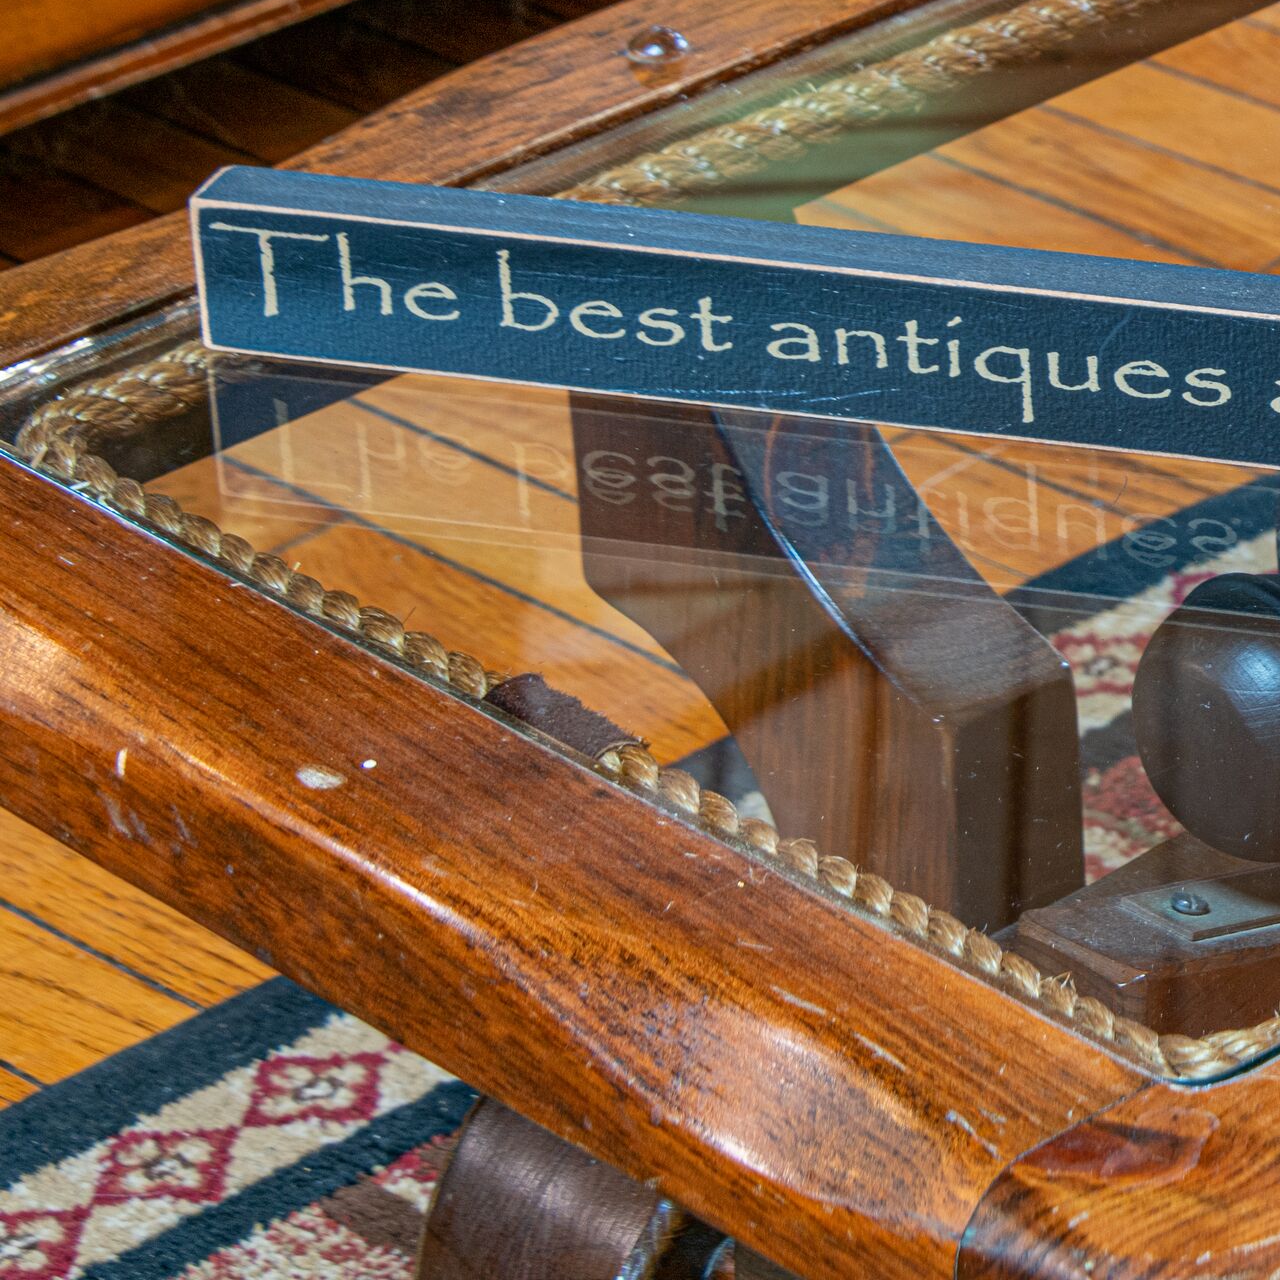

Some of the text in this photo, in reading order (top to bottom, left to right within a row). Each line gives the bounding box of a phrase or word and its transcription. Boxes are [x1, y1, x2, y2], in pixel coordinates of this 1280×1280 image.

[210, 221, 461, 322] The
[497, 249, 734, 353] best
[767, 318, 1233, 423] antiques
